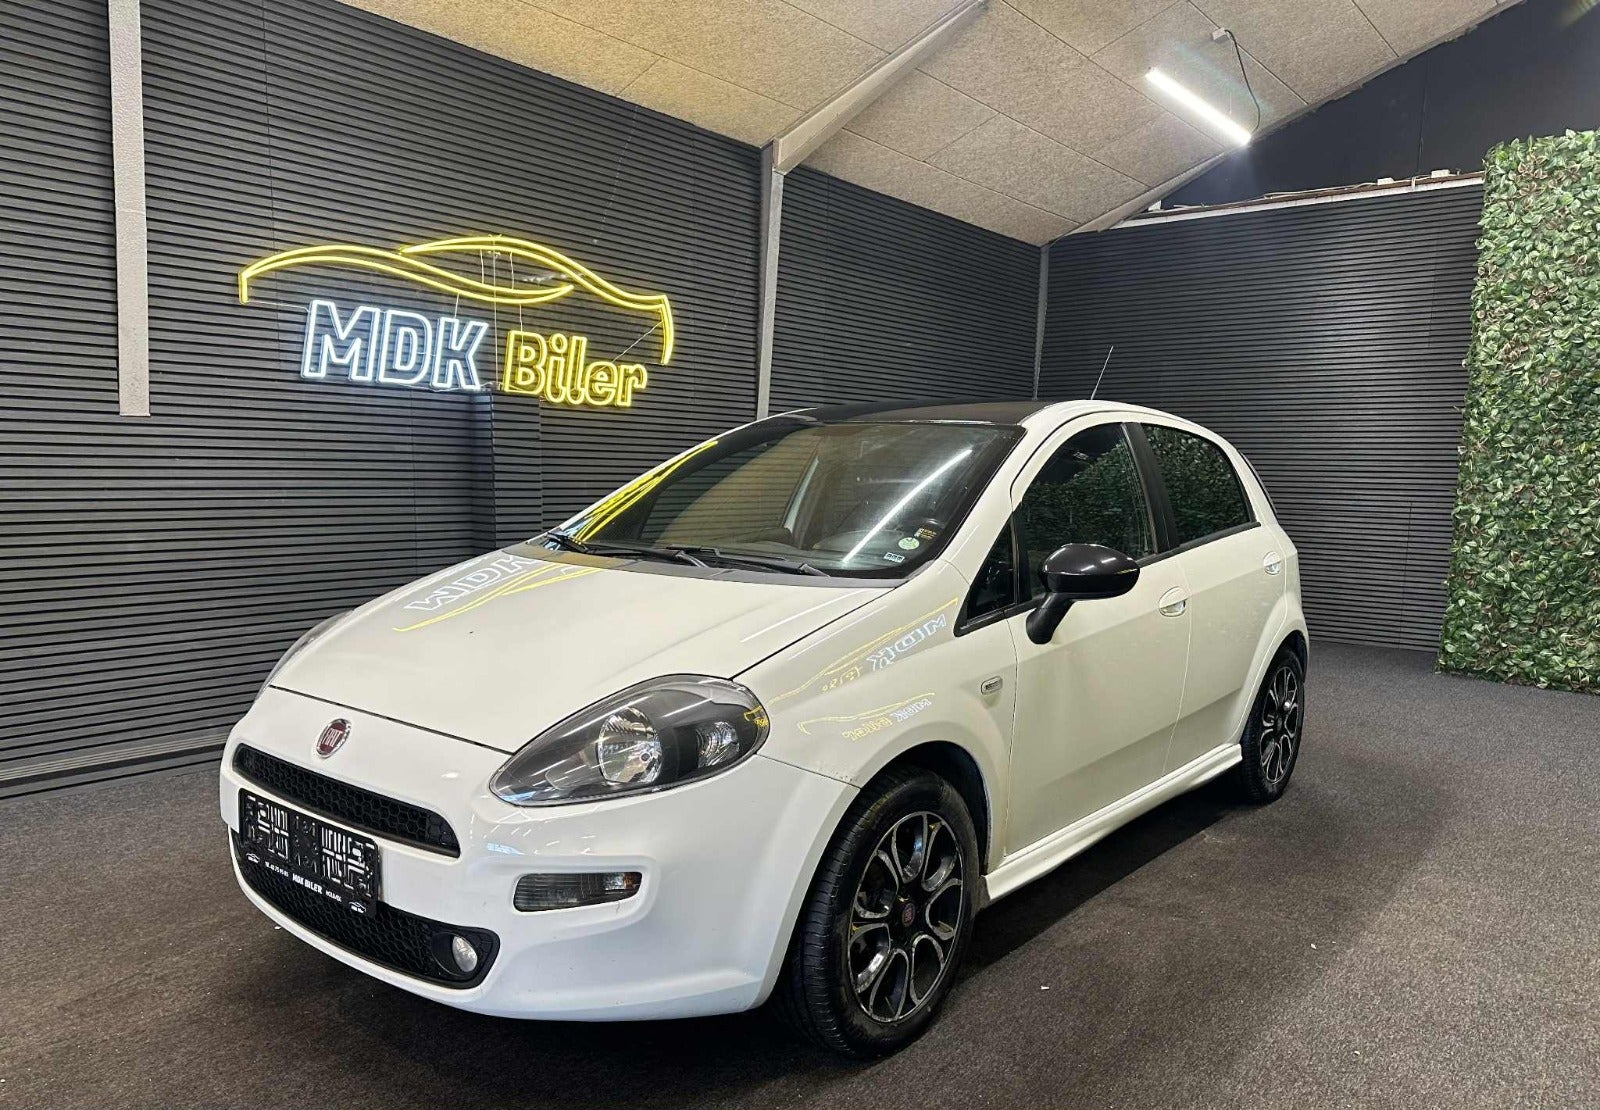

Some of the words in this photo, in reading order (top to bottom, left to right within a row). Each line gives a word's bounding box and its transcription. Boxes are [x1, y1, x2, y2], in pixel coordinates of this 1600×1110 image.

[302, 299, 489, 391] MDK
[503, 328, 649, 408] Biler
[322, 728, 343, 747] FIAT
[304, 878, 323, 895] BILER
